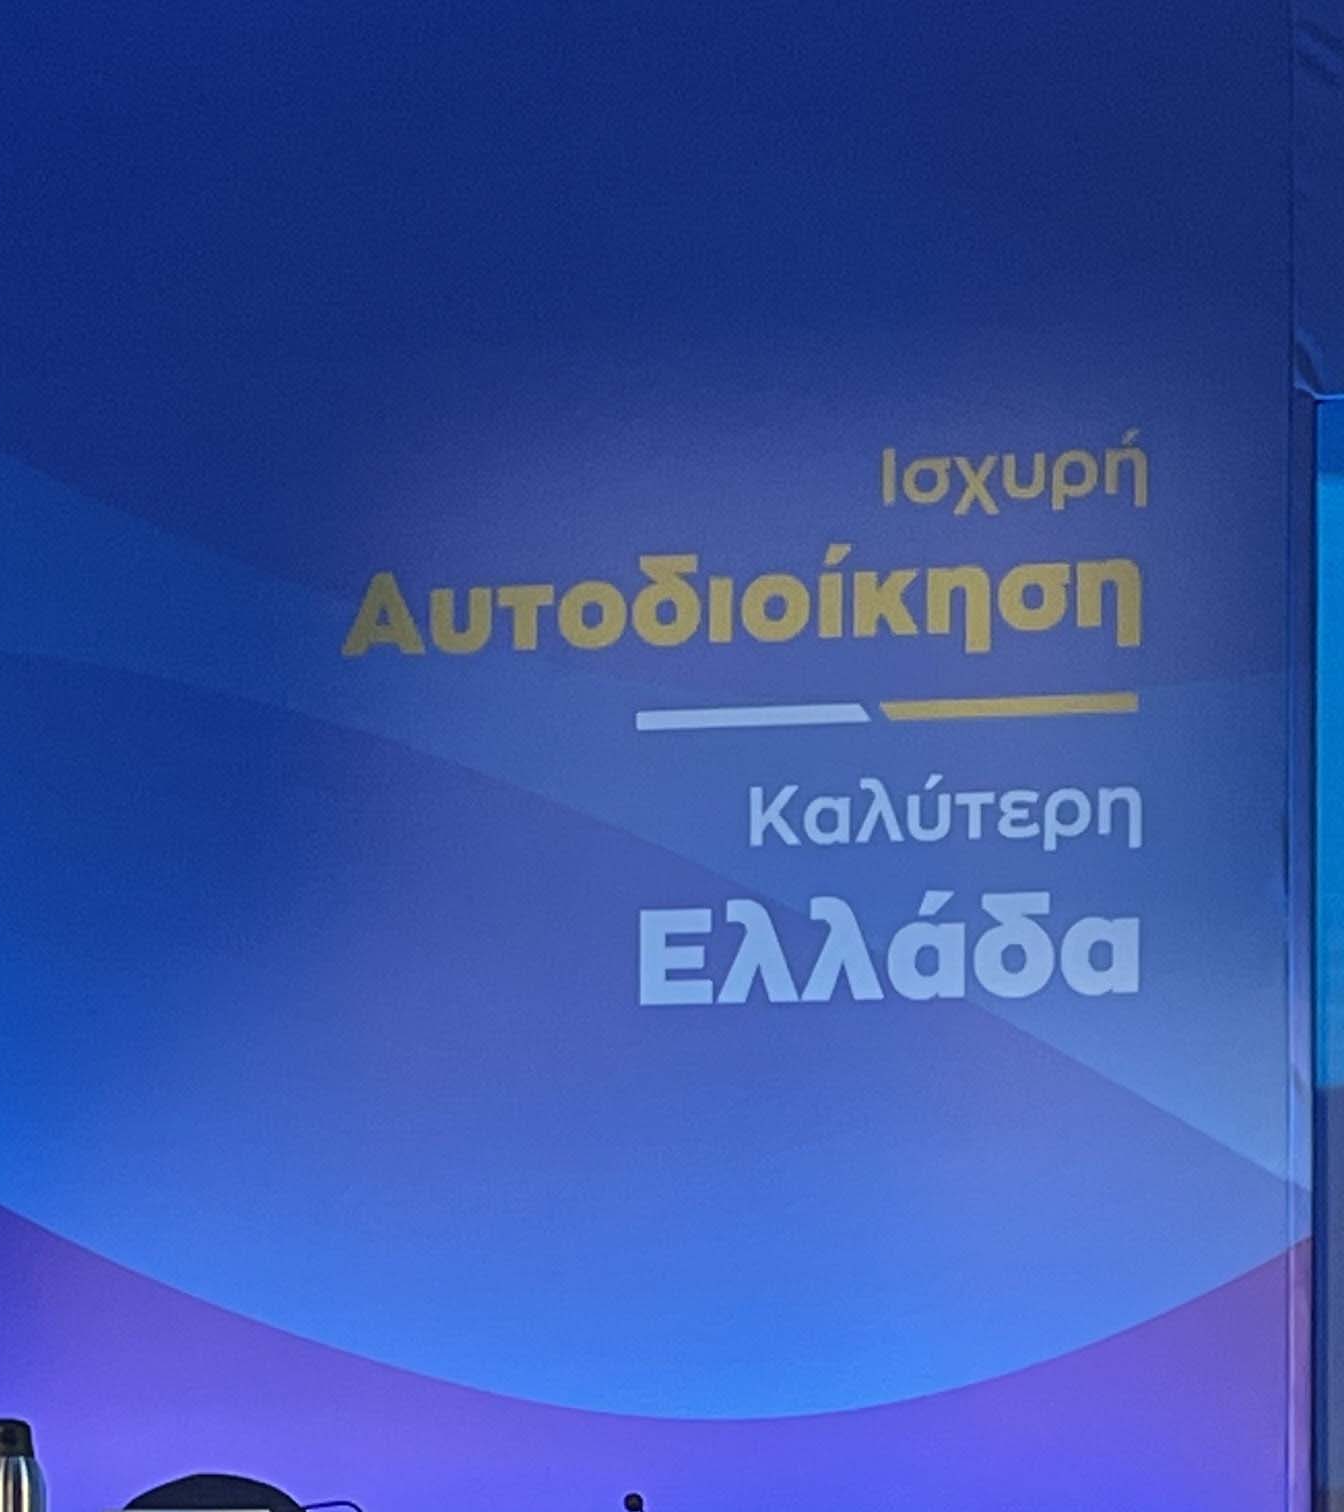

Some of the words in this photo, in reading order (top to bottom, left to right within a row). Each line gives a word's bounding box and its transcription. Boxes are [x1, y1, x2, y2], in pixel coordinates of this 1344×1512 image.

[882, 429, 1149, 515] Ισχυρή
[341, 544, 1142, 657] Αυτοδιοίκηση
[749, 774, 1143, 850] Καλύτερη
[639, 890, 1140, 1005] Ελλάδα
